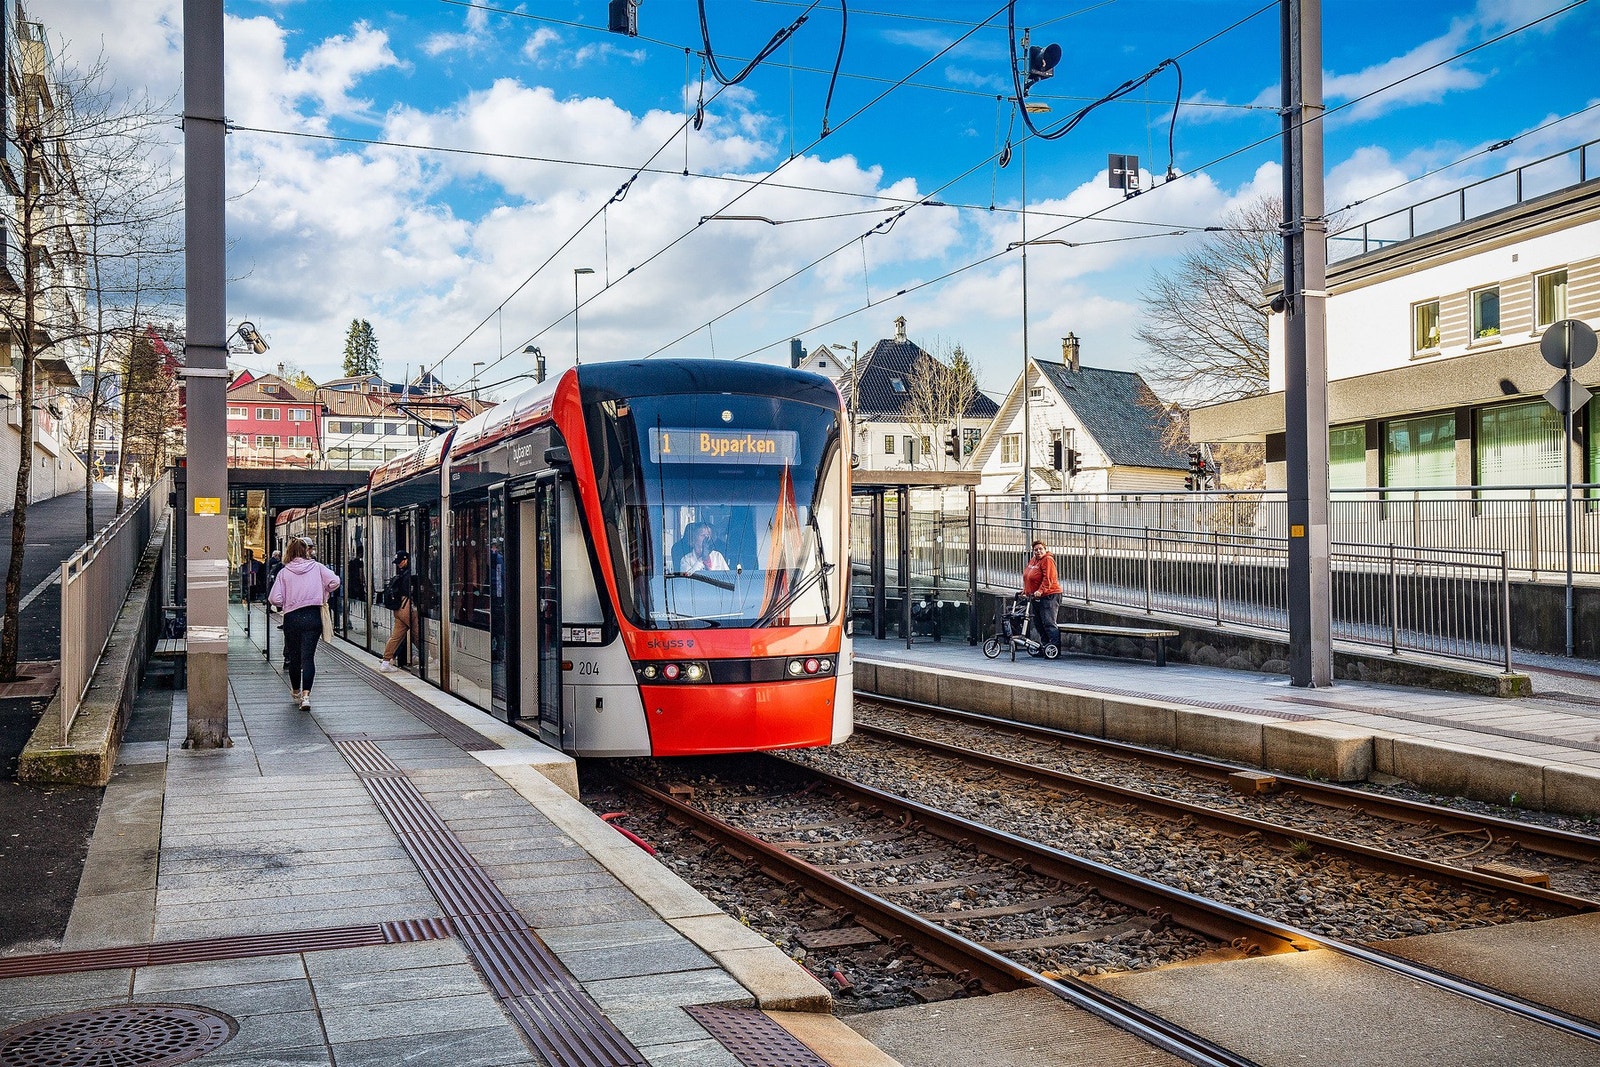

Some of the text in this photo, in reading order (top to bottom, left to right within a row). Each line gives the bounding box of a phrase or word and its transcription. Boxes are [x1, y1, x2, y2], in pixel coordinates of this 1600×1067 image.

[662, 433, 776, 457] 1 Byparken
[647, 638, 684, 650] skyss
[579, 661, 600, 676] 204
